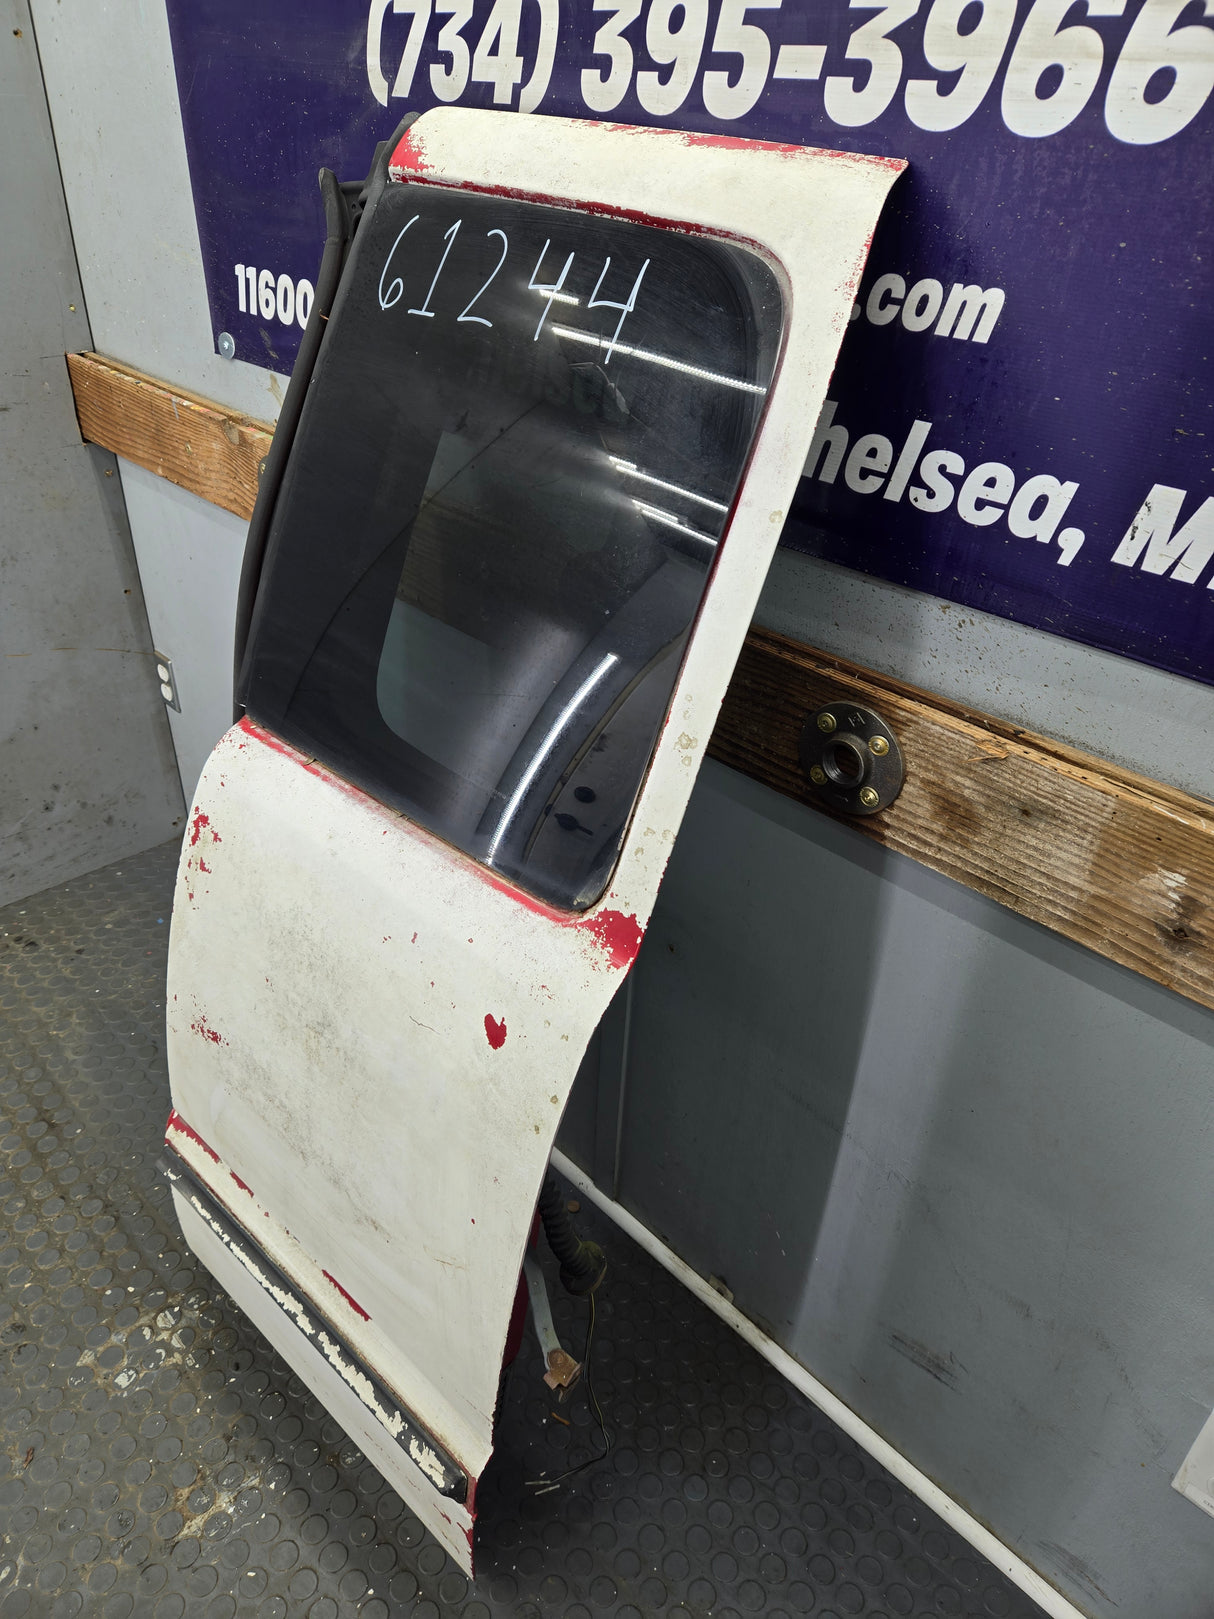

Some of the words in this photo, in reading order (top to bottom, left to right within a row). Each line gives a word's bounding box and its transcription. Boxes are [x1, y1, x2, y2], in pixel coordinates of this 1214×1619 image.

[580, 0, 1214, 145] 395-3966
[234, 264, 315, 331] 11600
[378, 215, 650, 364] 61244
[802, 400, 1085, 567] helsea,
[1110, 483, 1214, 590] M
